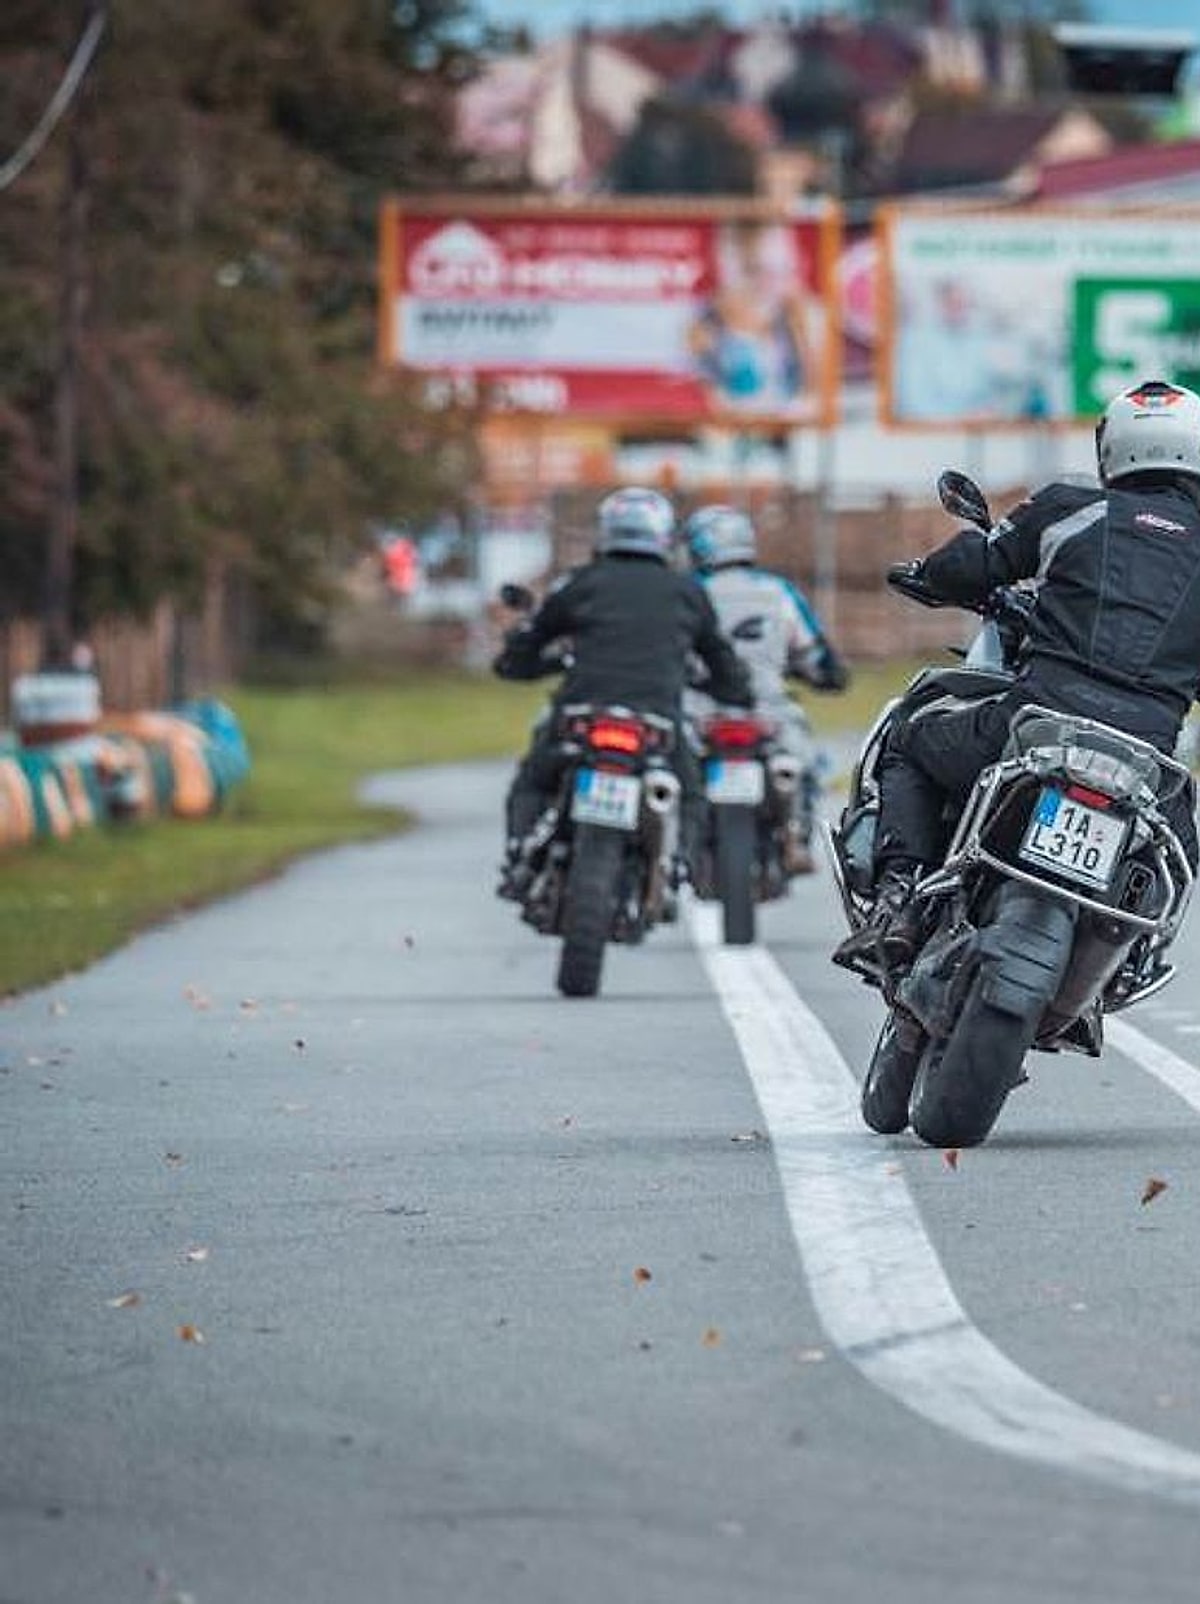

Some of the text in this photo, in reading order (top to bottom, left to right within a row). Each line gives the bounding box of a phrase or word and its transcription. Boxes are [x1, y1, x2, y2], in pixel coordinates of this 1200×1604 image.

[1091, 290, 1172, 404] 5
[1064, 807, 1091, 838] 1A
[1031, 824, 1100, 870] L310
